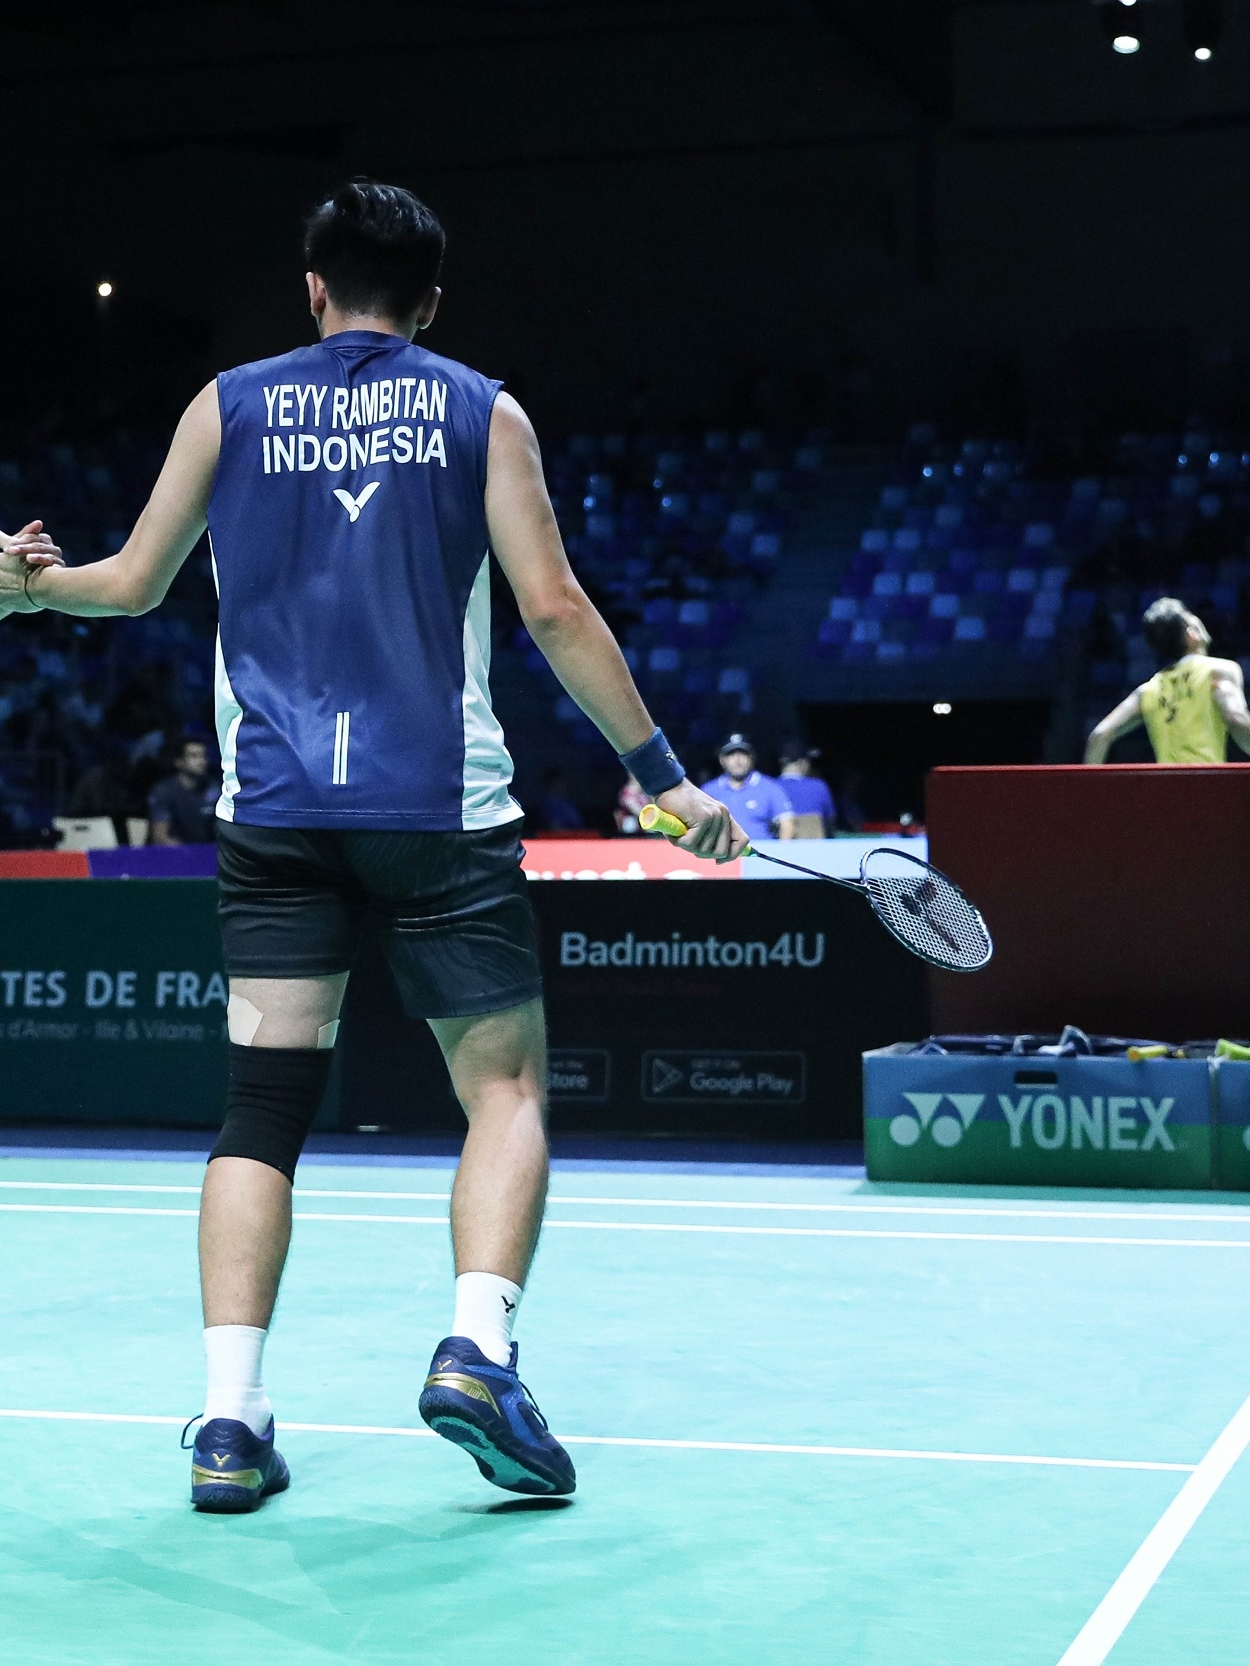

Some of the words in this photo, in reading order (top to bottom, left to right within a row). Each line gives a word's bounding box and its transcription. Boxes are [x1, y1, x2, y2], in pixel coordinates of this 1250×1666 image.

[262, 384, 328, 428] YEYY
[331, 377, 448, 430] RAMBITAN
[262, 425, 448, 474] INDONESIA
[559, 931, 826, 968] Badminton4U
[85, 970, 138, 1008] DE
[156, 971, 228, 1008] FRA
[690, 1071, 754, 1095] Google
[757, 1072, 794, 1096] Play
[997, 1093, 1176, 1152] YONEX
